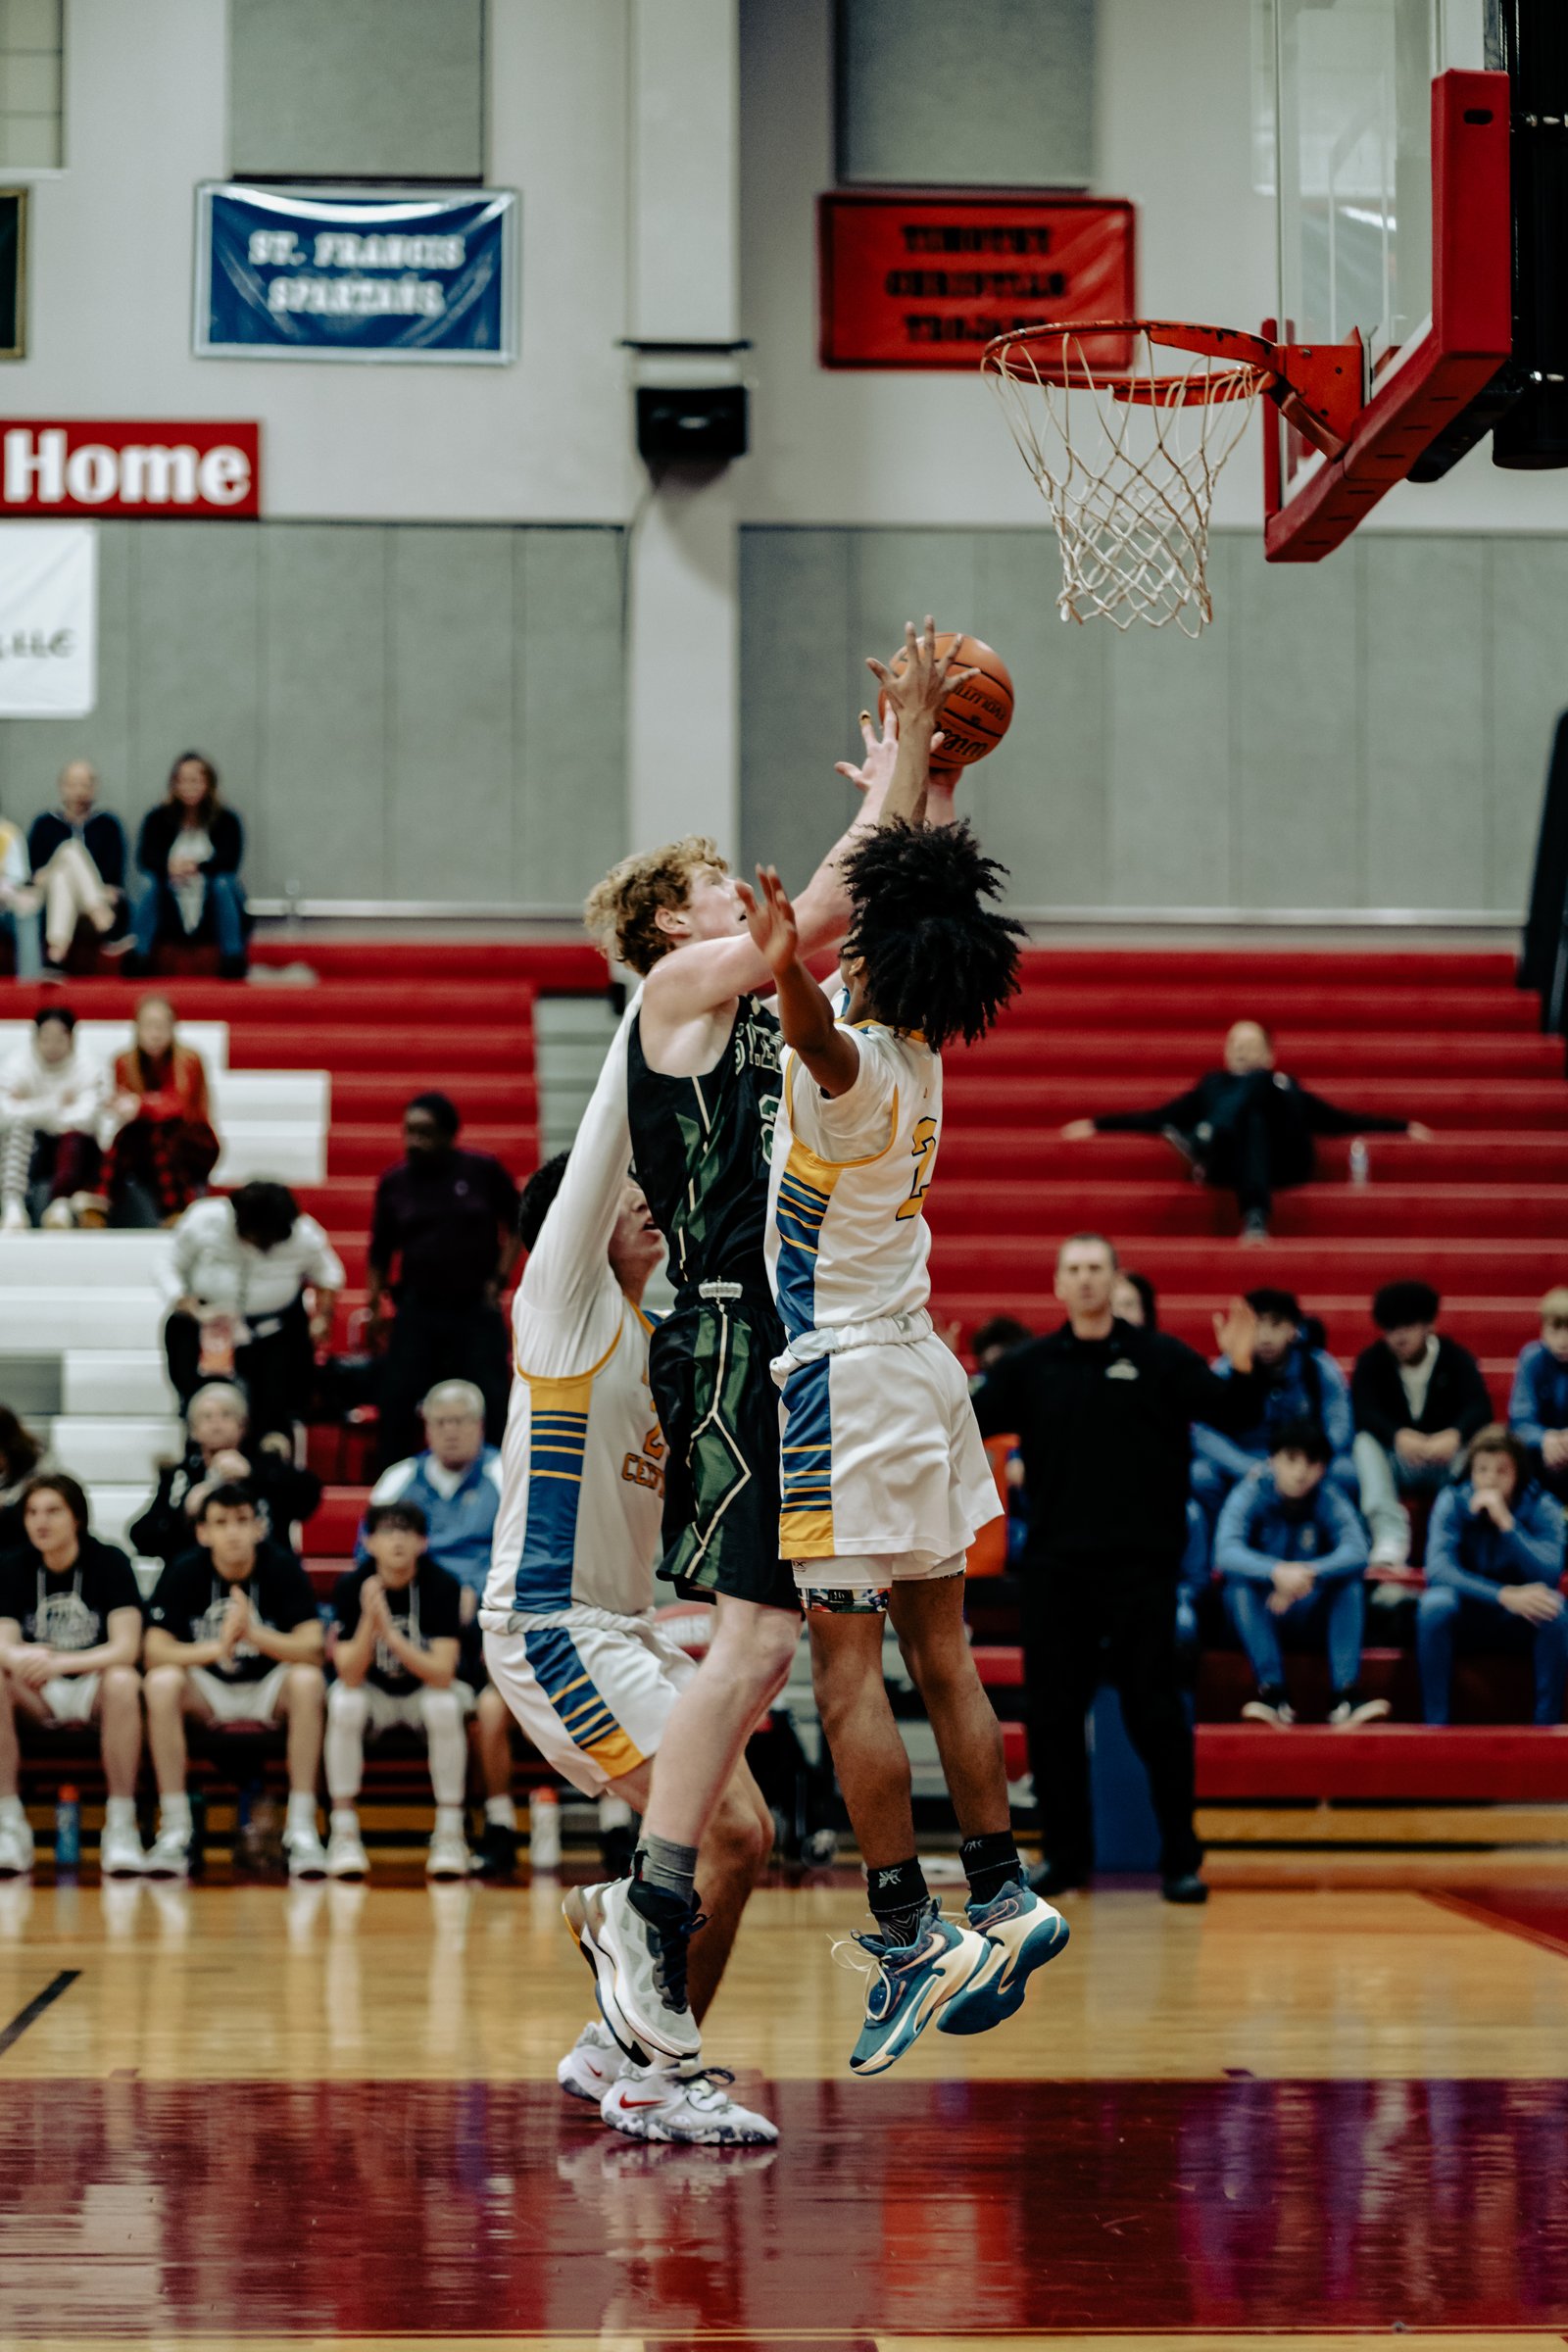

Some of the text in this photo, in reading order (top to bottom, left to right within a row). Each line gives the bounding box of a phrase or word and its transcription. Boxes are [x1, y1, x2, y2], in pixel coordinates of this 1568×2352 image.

[248, 229, 466, 270] ST. FRANCIS
[268, 276, 446, 317] SPARTANS
[3, 428, 252, 506] Home
[896, 1116, 937, 1221] 2
